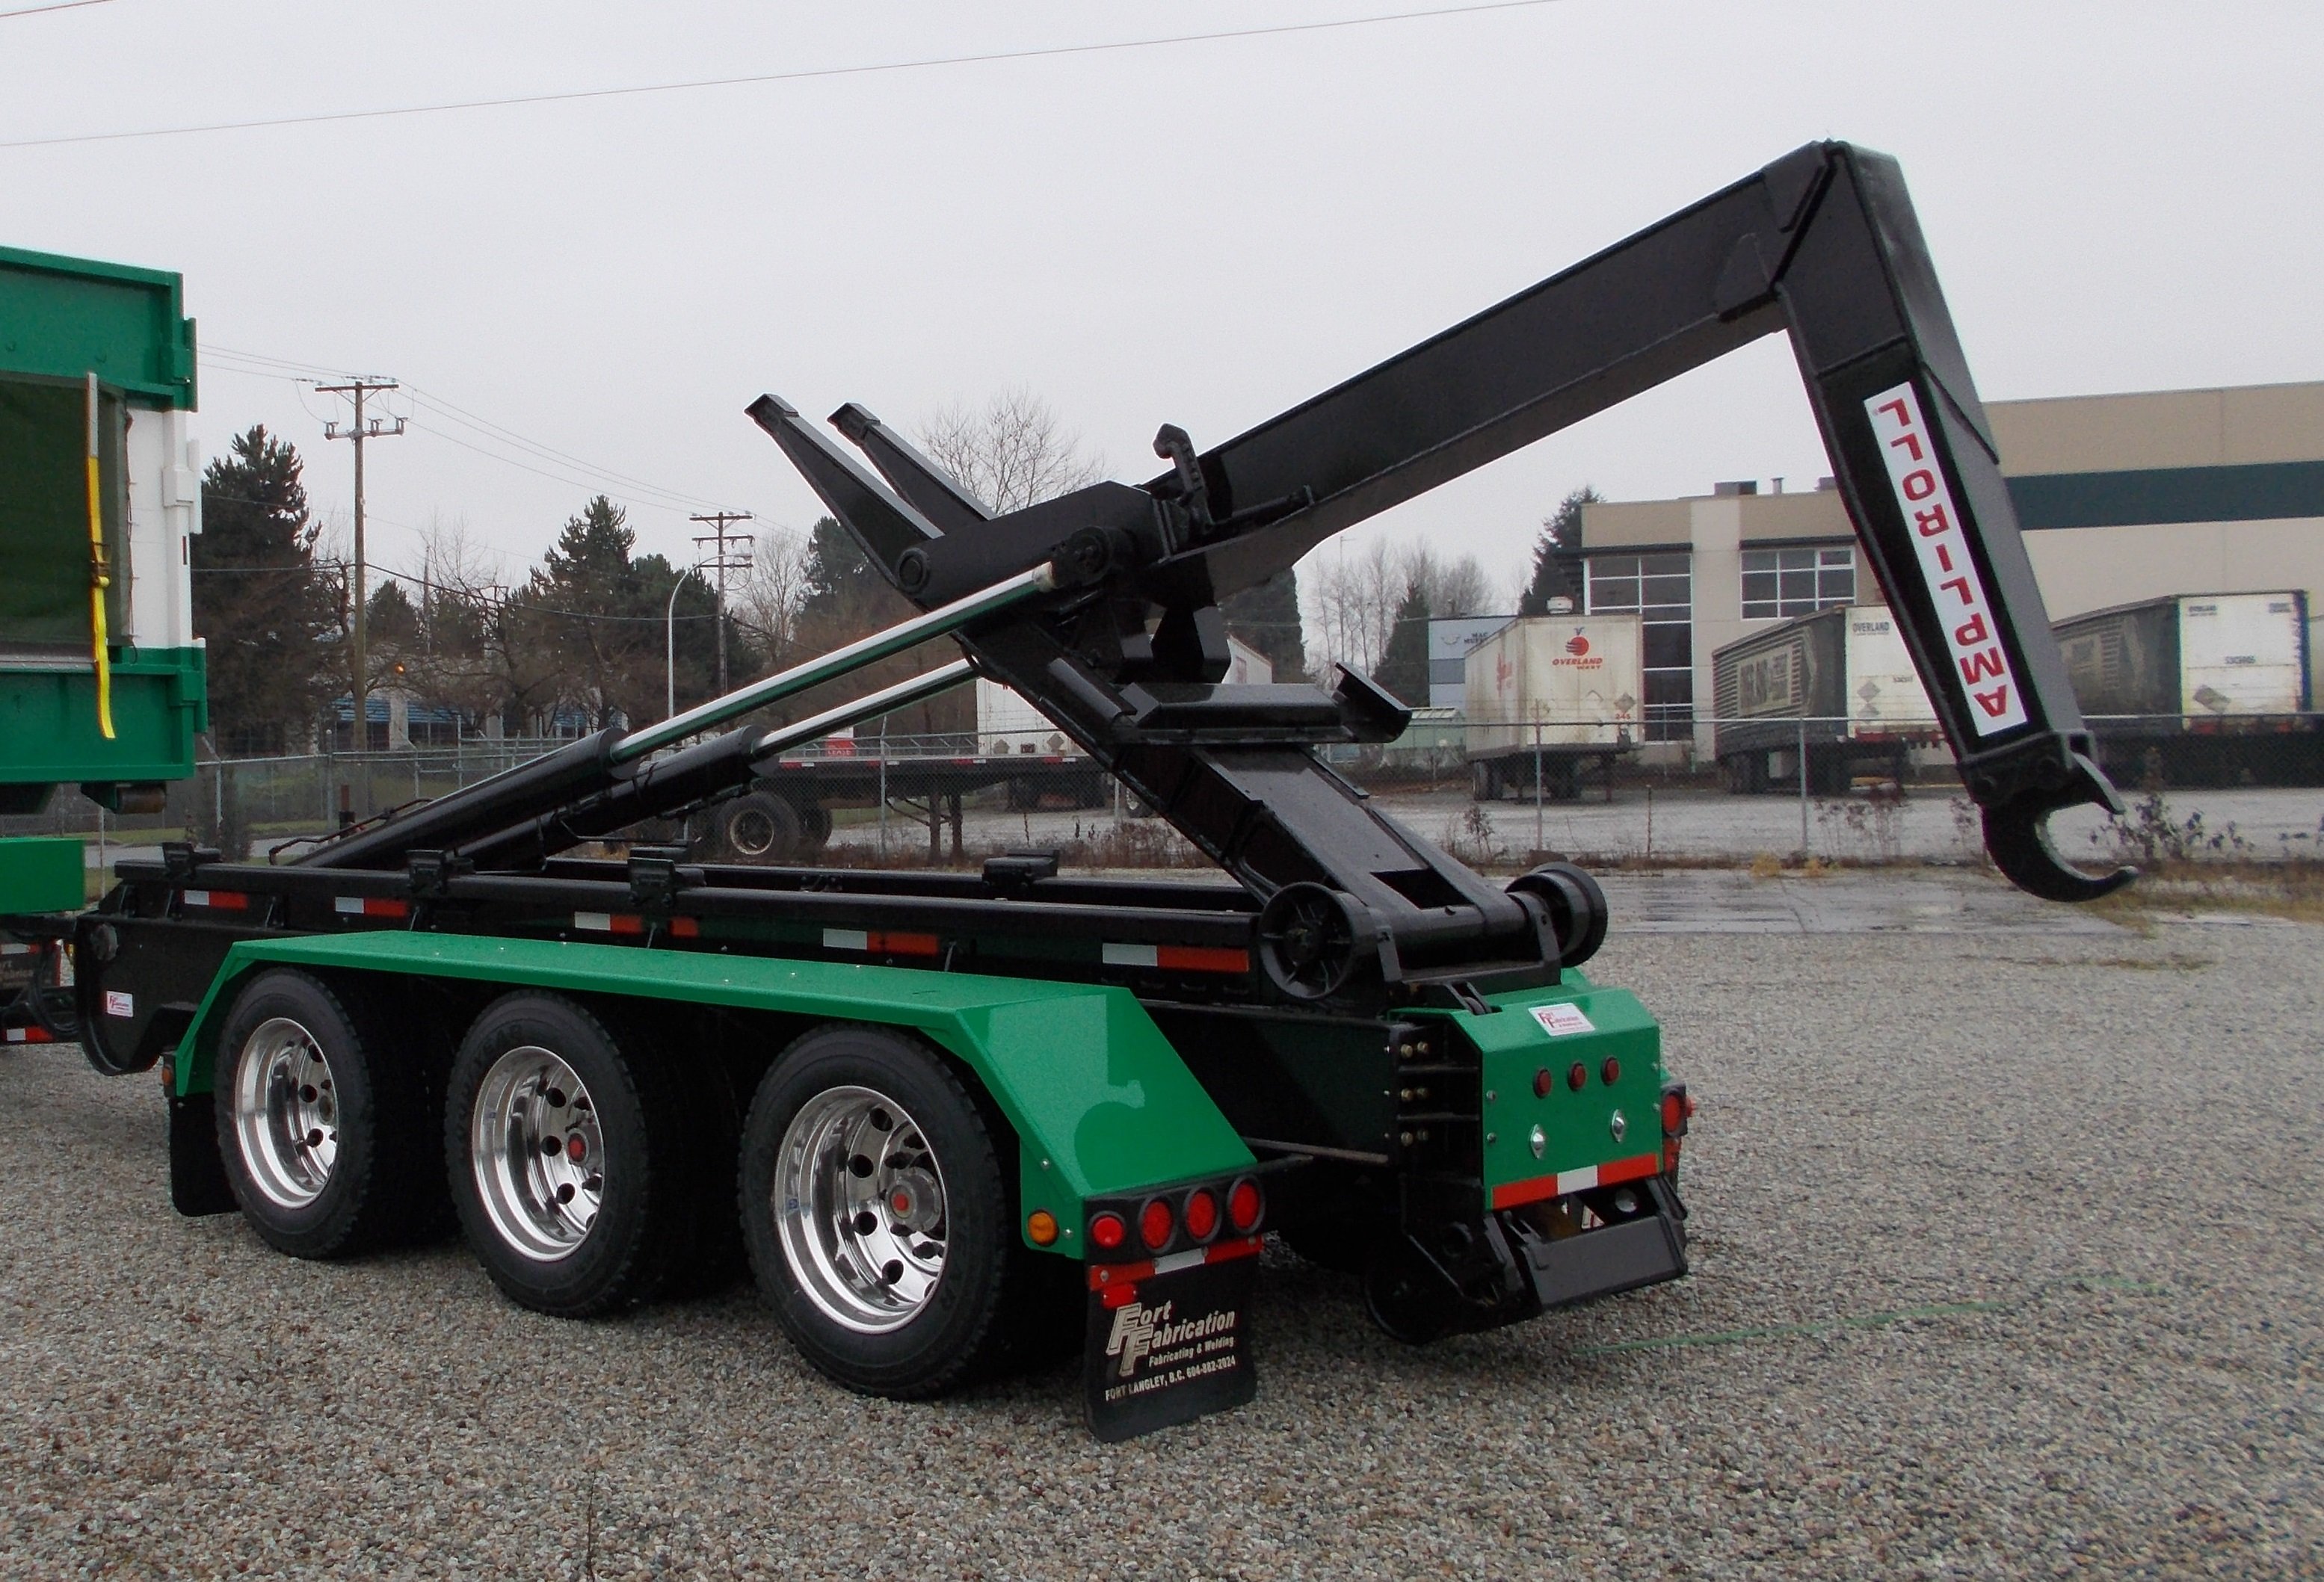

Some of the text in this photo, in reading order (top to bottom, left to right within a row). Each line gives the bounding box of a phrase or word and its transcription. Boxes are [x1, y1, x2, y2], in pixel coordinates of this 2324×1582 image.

[1875, 398, 2009, 718] AMPLIROLL
[1552, 657, 1603, 666] OVERLAND
[1106, 1300, 1171, 1356] Fort
[1118, 1311, 1235, 1376] Fabrication
[1149, 1347, 1194, 1368] Fabricating
[1204, 1336, 1234, 1351] Welding
[1105, 1385, 1126, 1402] FORT
[1128, 1374, 1168, 1394] LANGLEY,
[1169, 1370, 1186, 1384] B.C.
